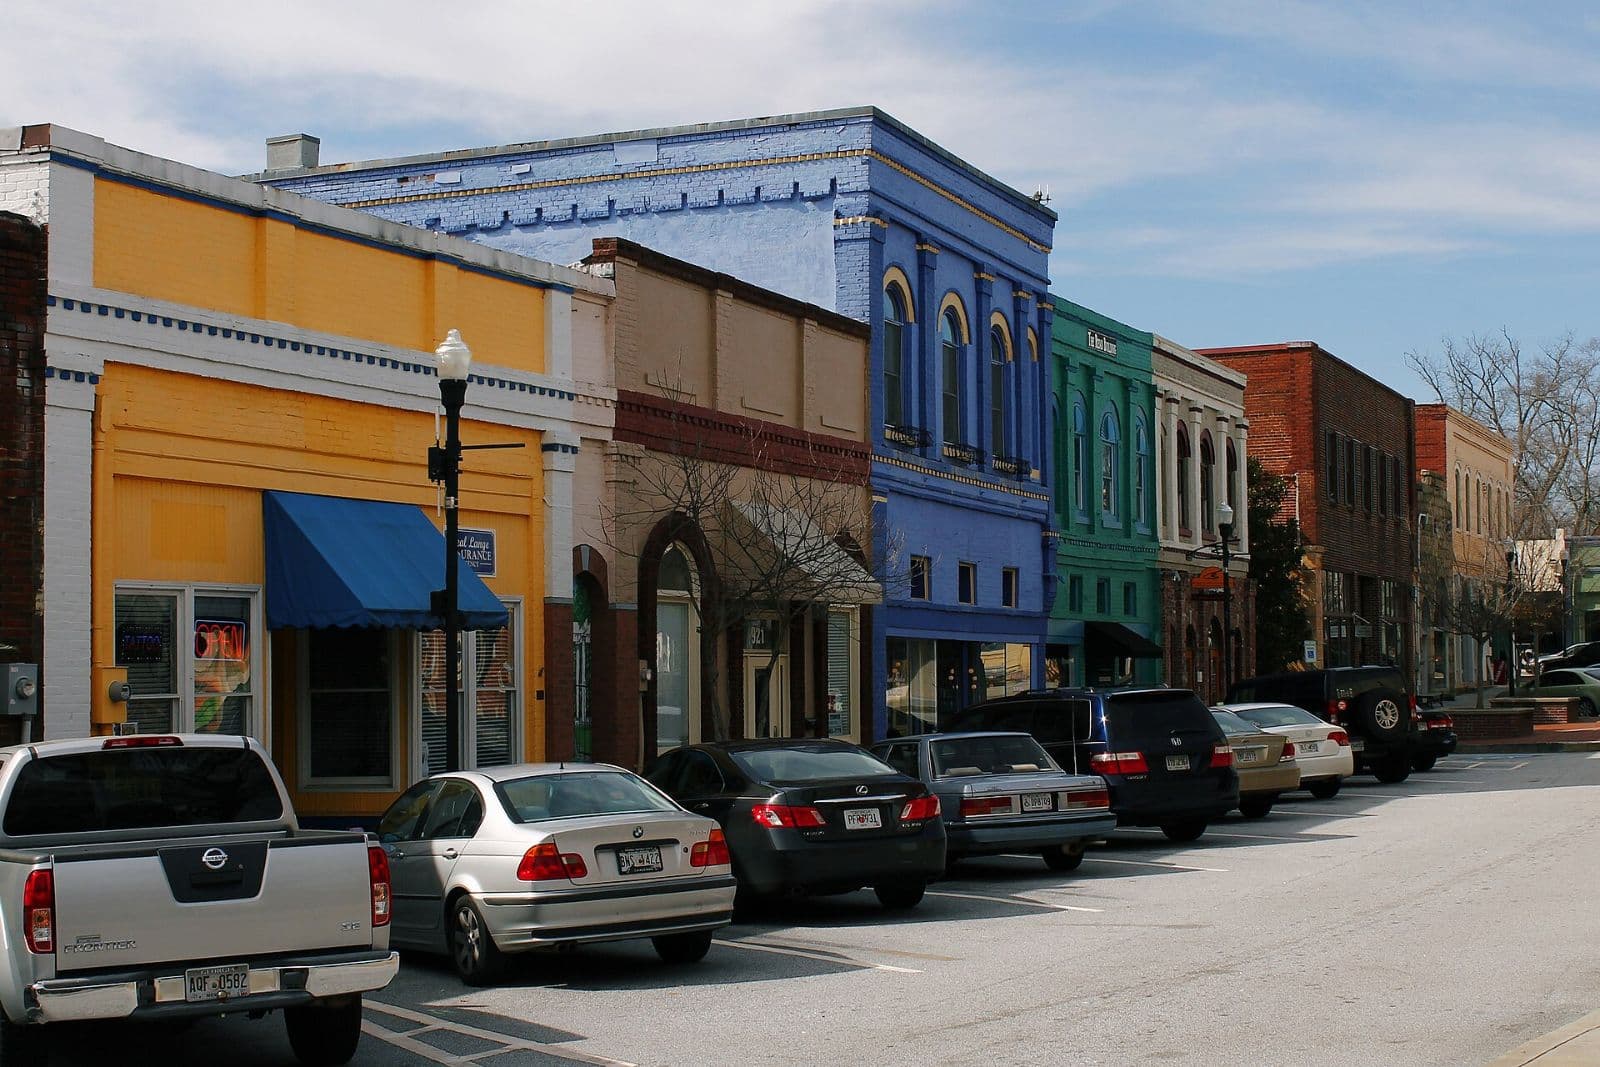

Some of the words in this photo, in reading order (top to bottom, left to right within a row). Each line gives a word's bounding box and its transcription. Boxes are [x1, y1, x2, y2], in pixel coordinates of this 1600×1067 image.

[195, 623, 244, 660] OPEN
[63, 940, 137, 954] FRONTIER
[190, 975, 210, 993] AQF
[219, 973, 248, 990] 0582
